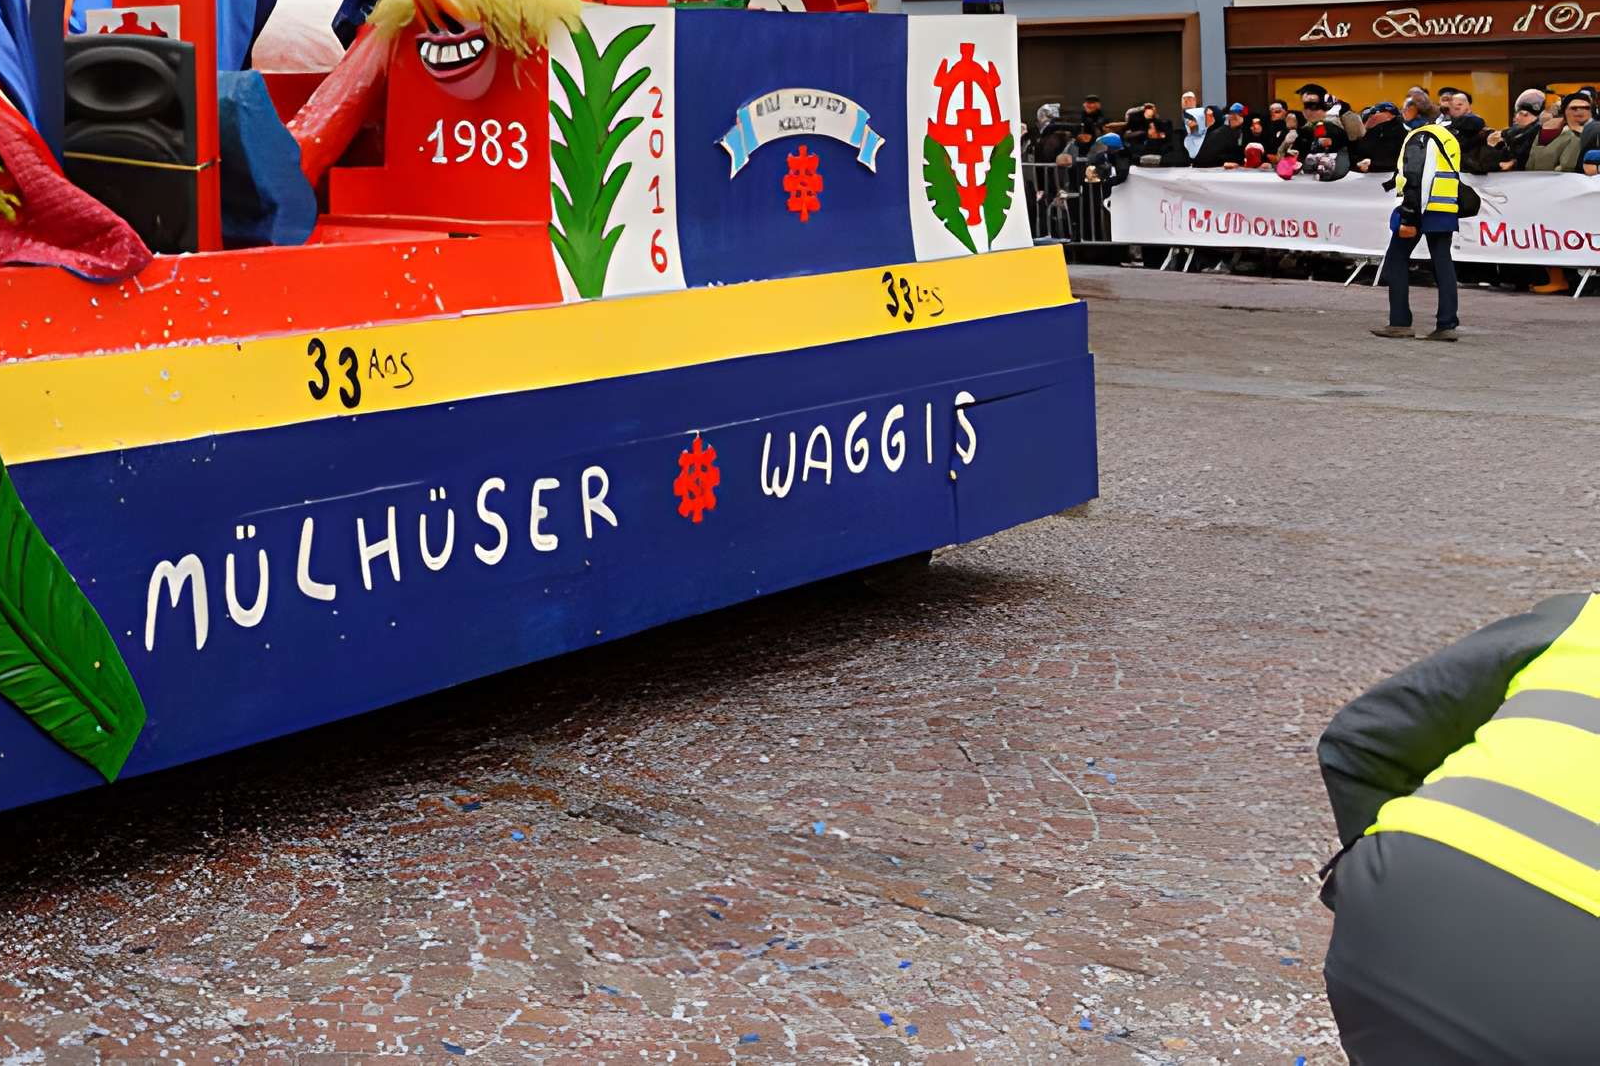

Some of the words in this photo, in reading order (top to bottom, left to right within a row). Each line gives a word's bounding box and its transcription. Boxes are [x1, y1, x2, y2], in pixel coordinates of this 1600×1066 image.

[426, 118, 529, 170] 1983
[647, 85, 669, 274] 2016
[881, 270, 915, 324] 33
[307, 337, 362, 410] 33
[760, 390, 977, 499] WAGGIS
[144, 466, 618, 652] MÜLHÜSER
